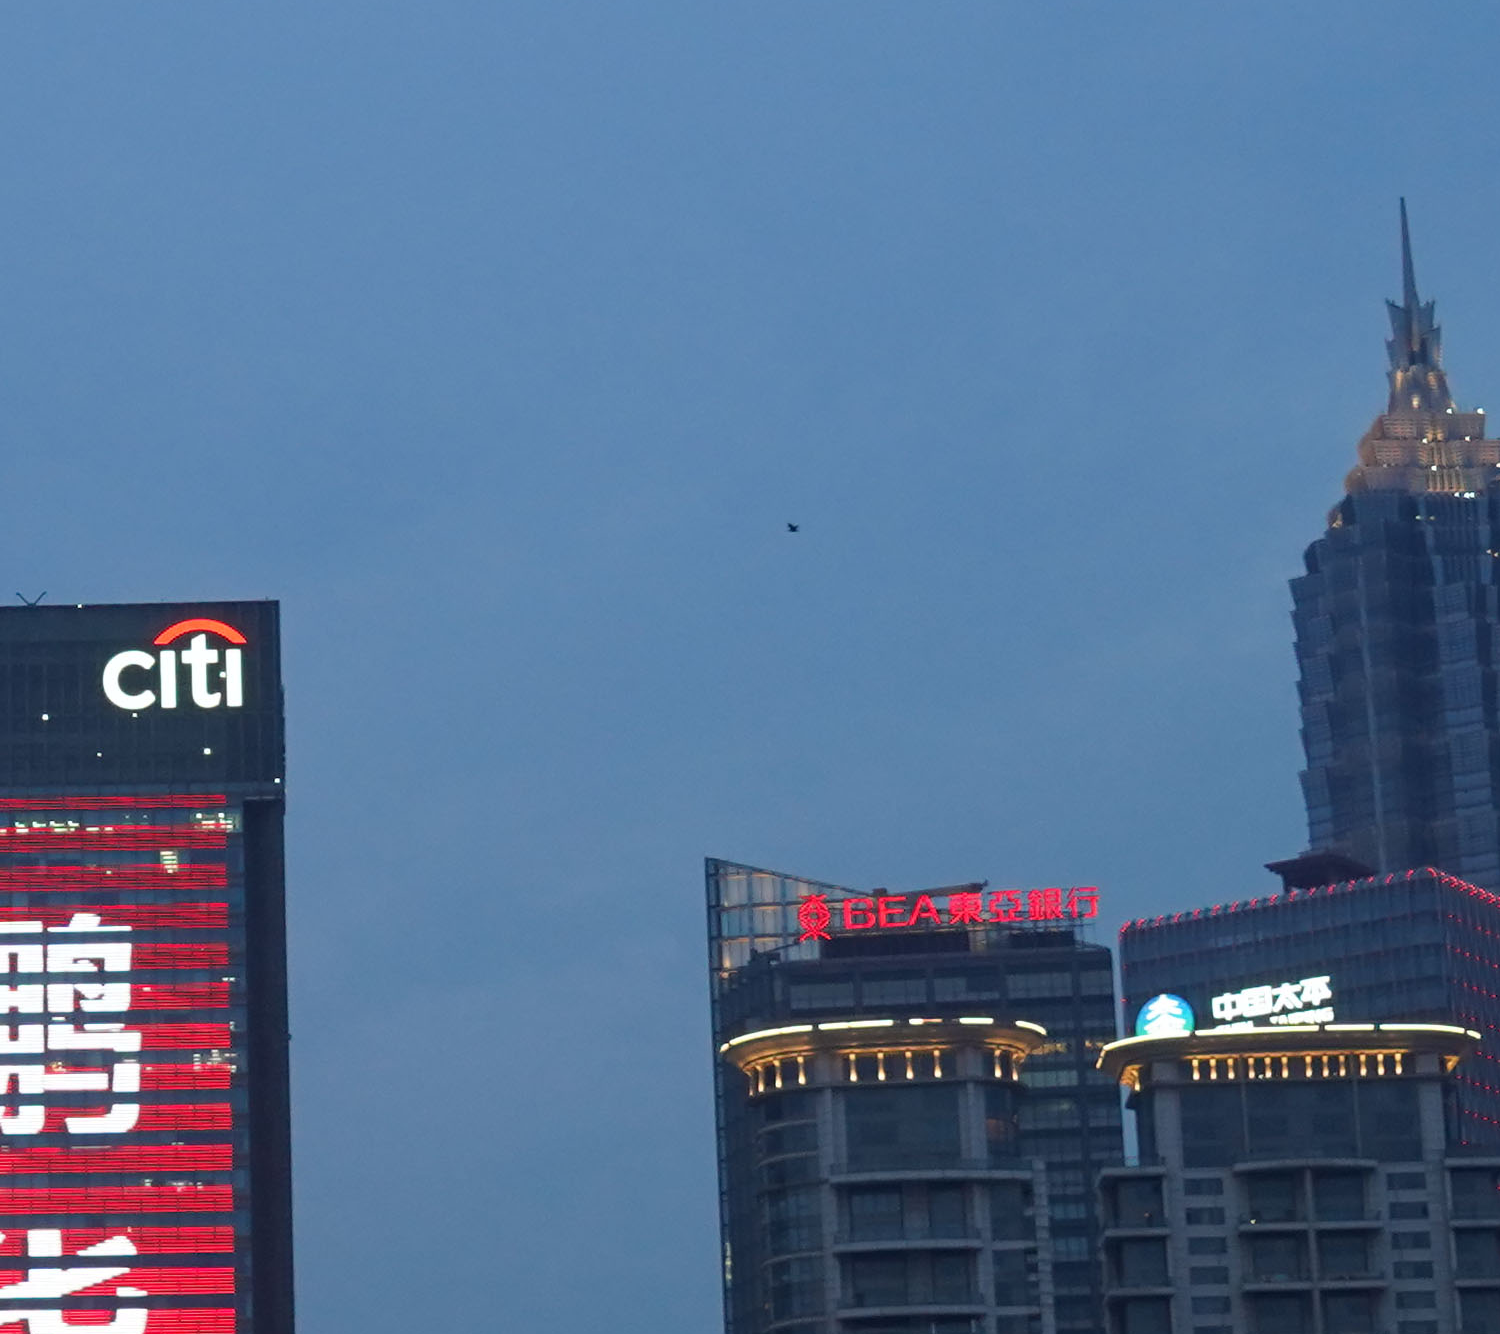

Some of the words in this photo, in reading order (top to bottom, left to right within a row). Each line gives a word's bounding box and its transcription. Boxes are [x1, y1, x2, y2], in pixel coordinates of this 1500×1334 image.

[102, 633, 245, 710] citi
[843, 894, 942, 930] BEA
[948, 886, 1100, 925] 東亞銀行
[1211, 975, 1333, 1021] 中国太平
